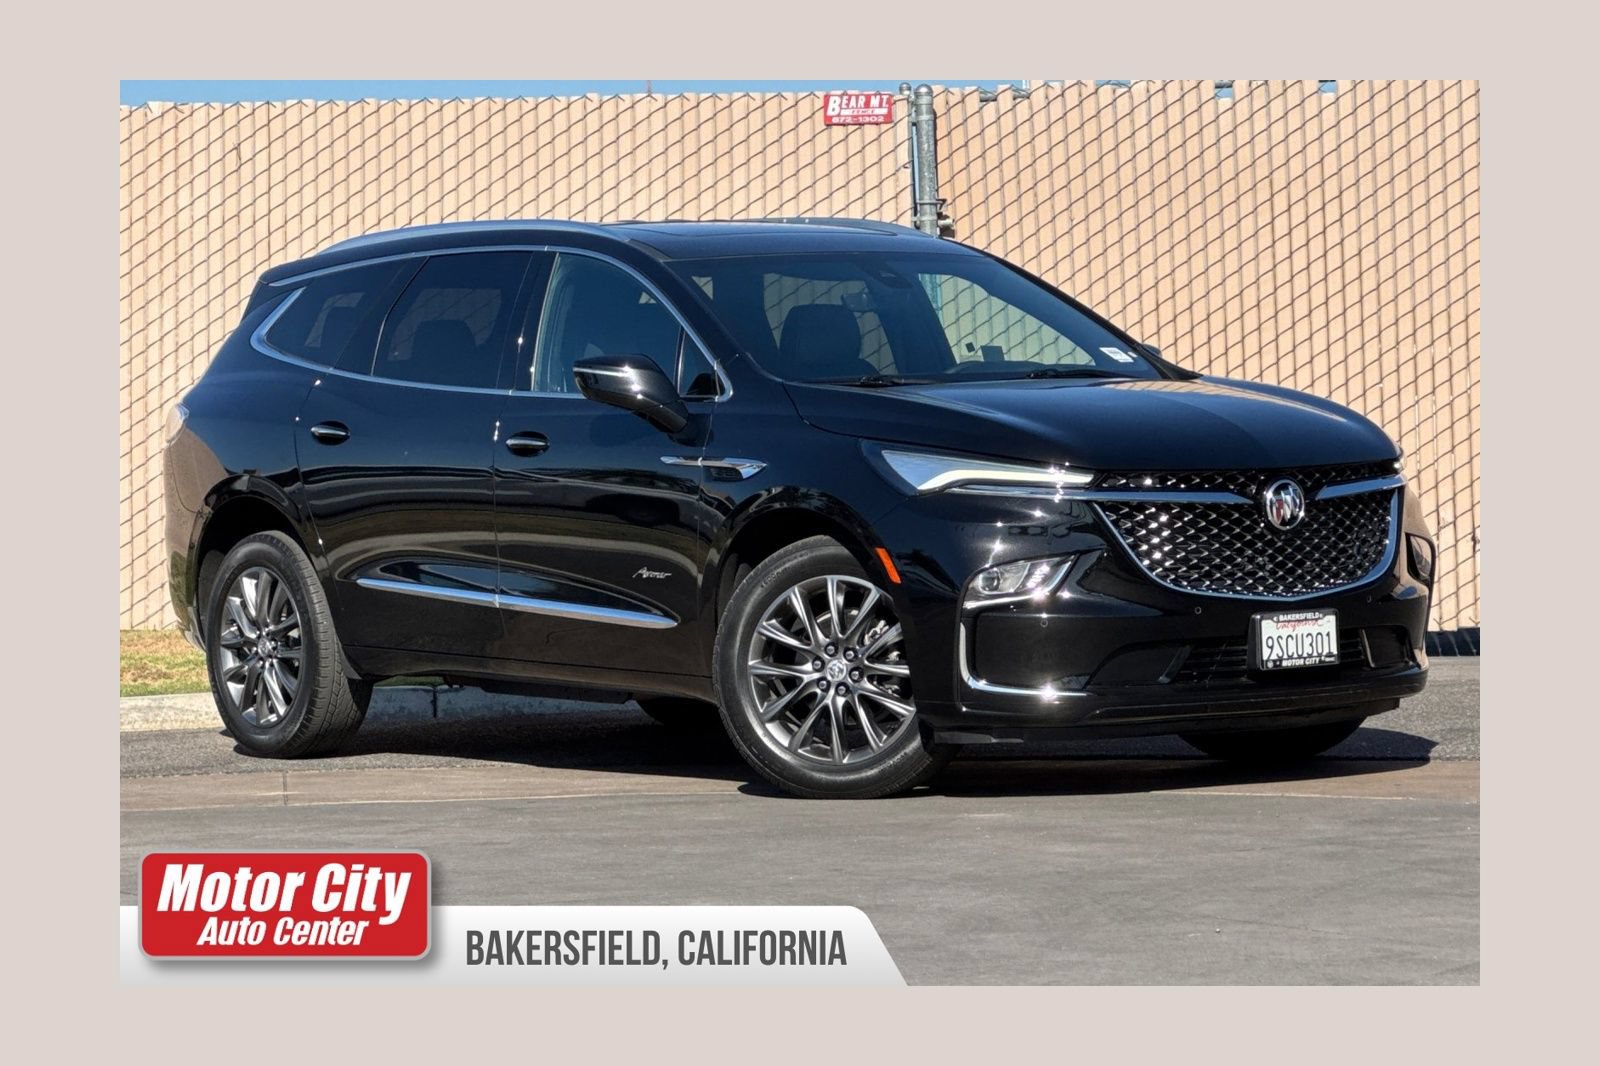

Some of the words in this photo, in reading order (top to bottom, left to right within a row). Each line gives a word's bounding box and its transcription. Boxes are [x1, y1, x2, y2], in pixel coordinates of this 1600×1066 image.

[827, 95, 866, 116] BEAR
[1279, 612, 1320, 621] BAKERSFIELD
[1266, 631, 1332, 661] 9SCU301
[1282, 658, 1304, 667] MOTOR
[1305, 657, 1320, 665] CITY
